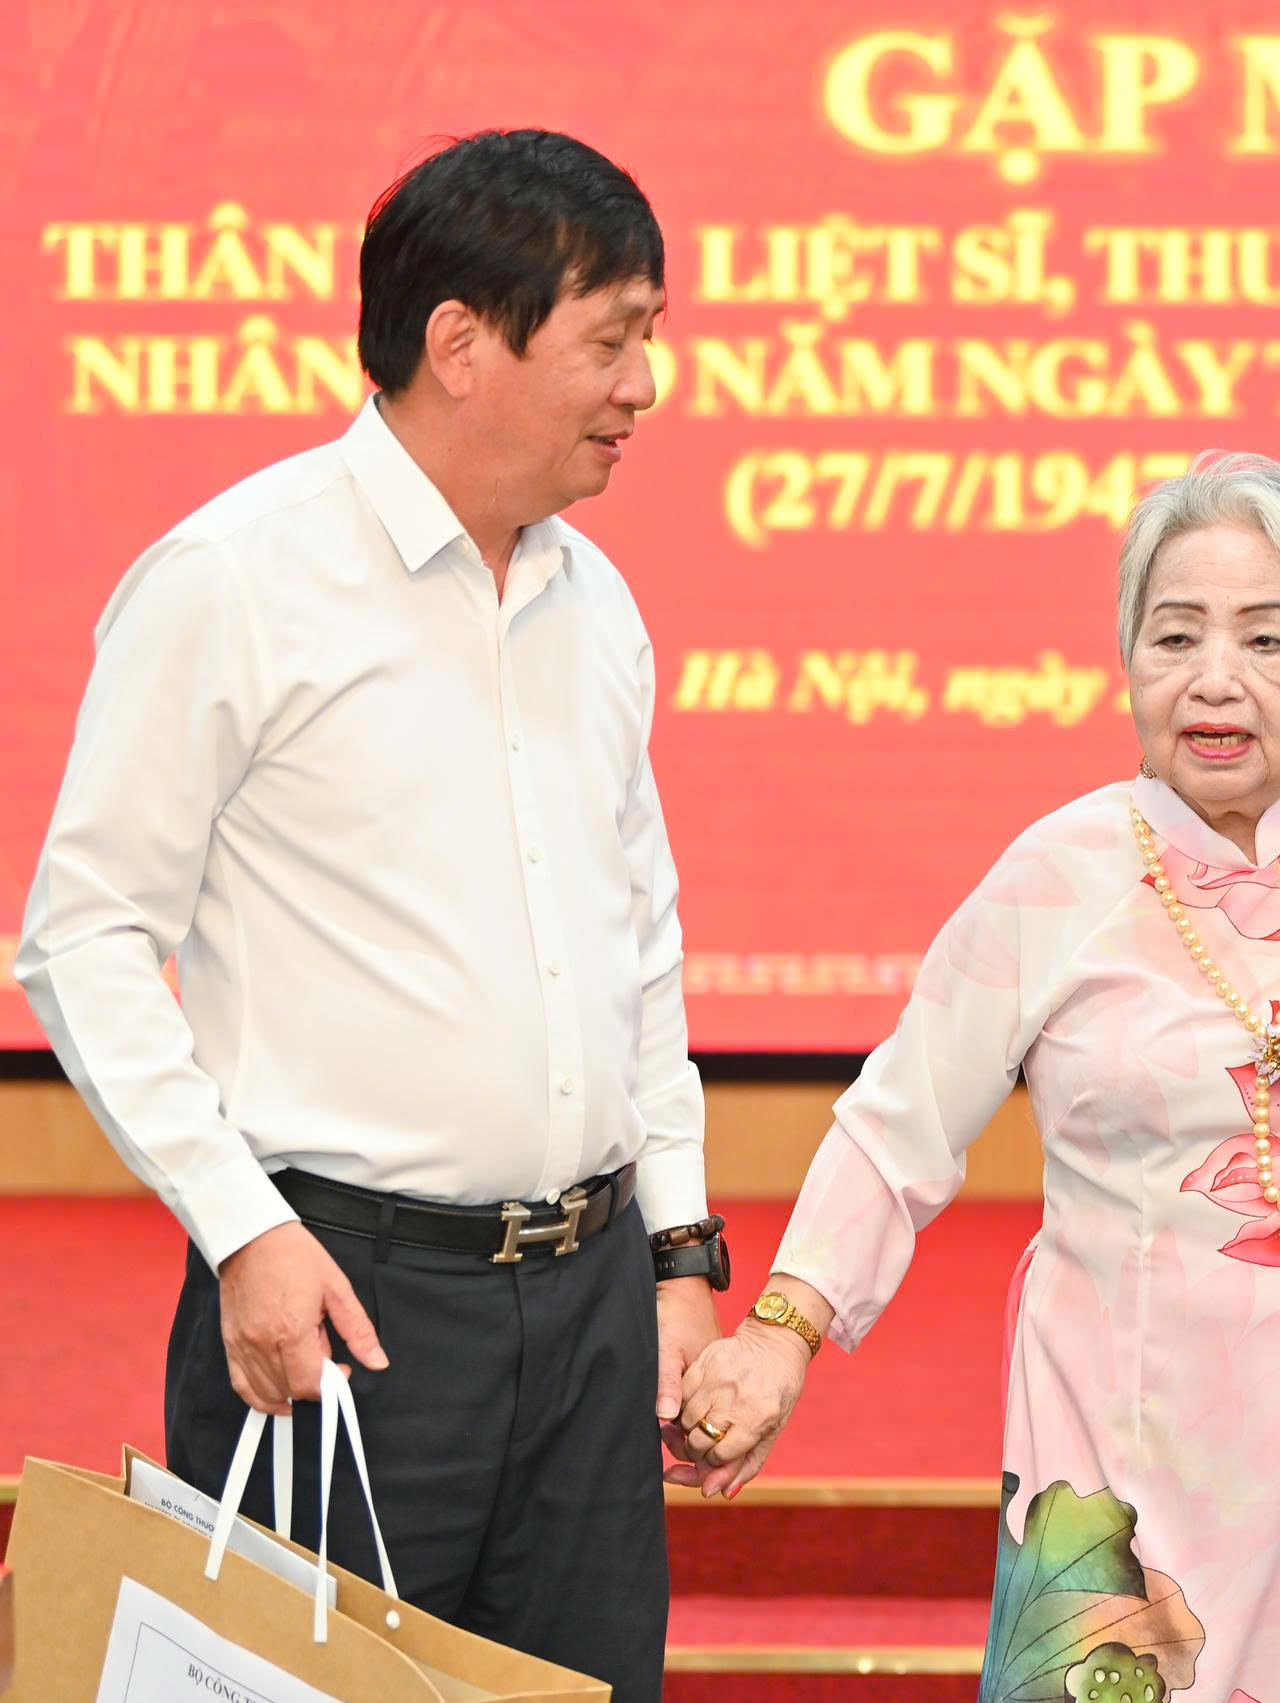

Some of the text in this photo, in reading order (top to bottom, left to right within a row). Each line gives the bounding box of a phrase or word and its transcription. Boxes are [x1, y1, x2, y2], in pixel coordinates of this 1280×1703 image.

[822, 13, 1200, 186] GẶP
[46, 202, 337, 300] THÂN
[697, 210, 939, 322] LIỆT
[952, 208, 1075, 318] SĨ,
[70, 315, 367, 413] NHÂN
[693, 320, 937, 414] NĂM
[954, 318, 1252, 418] NGÀY
[675, 650, 778, 711] Hà
